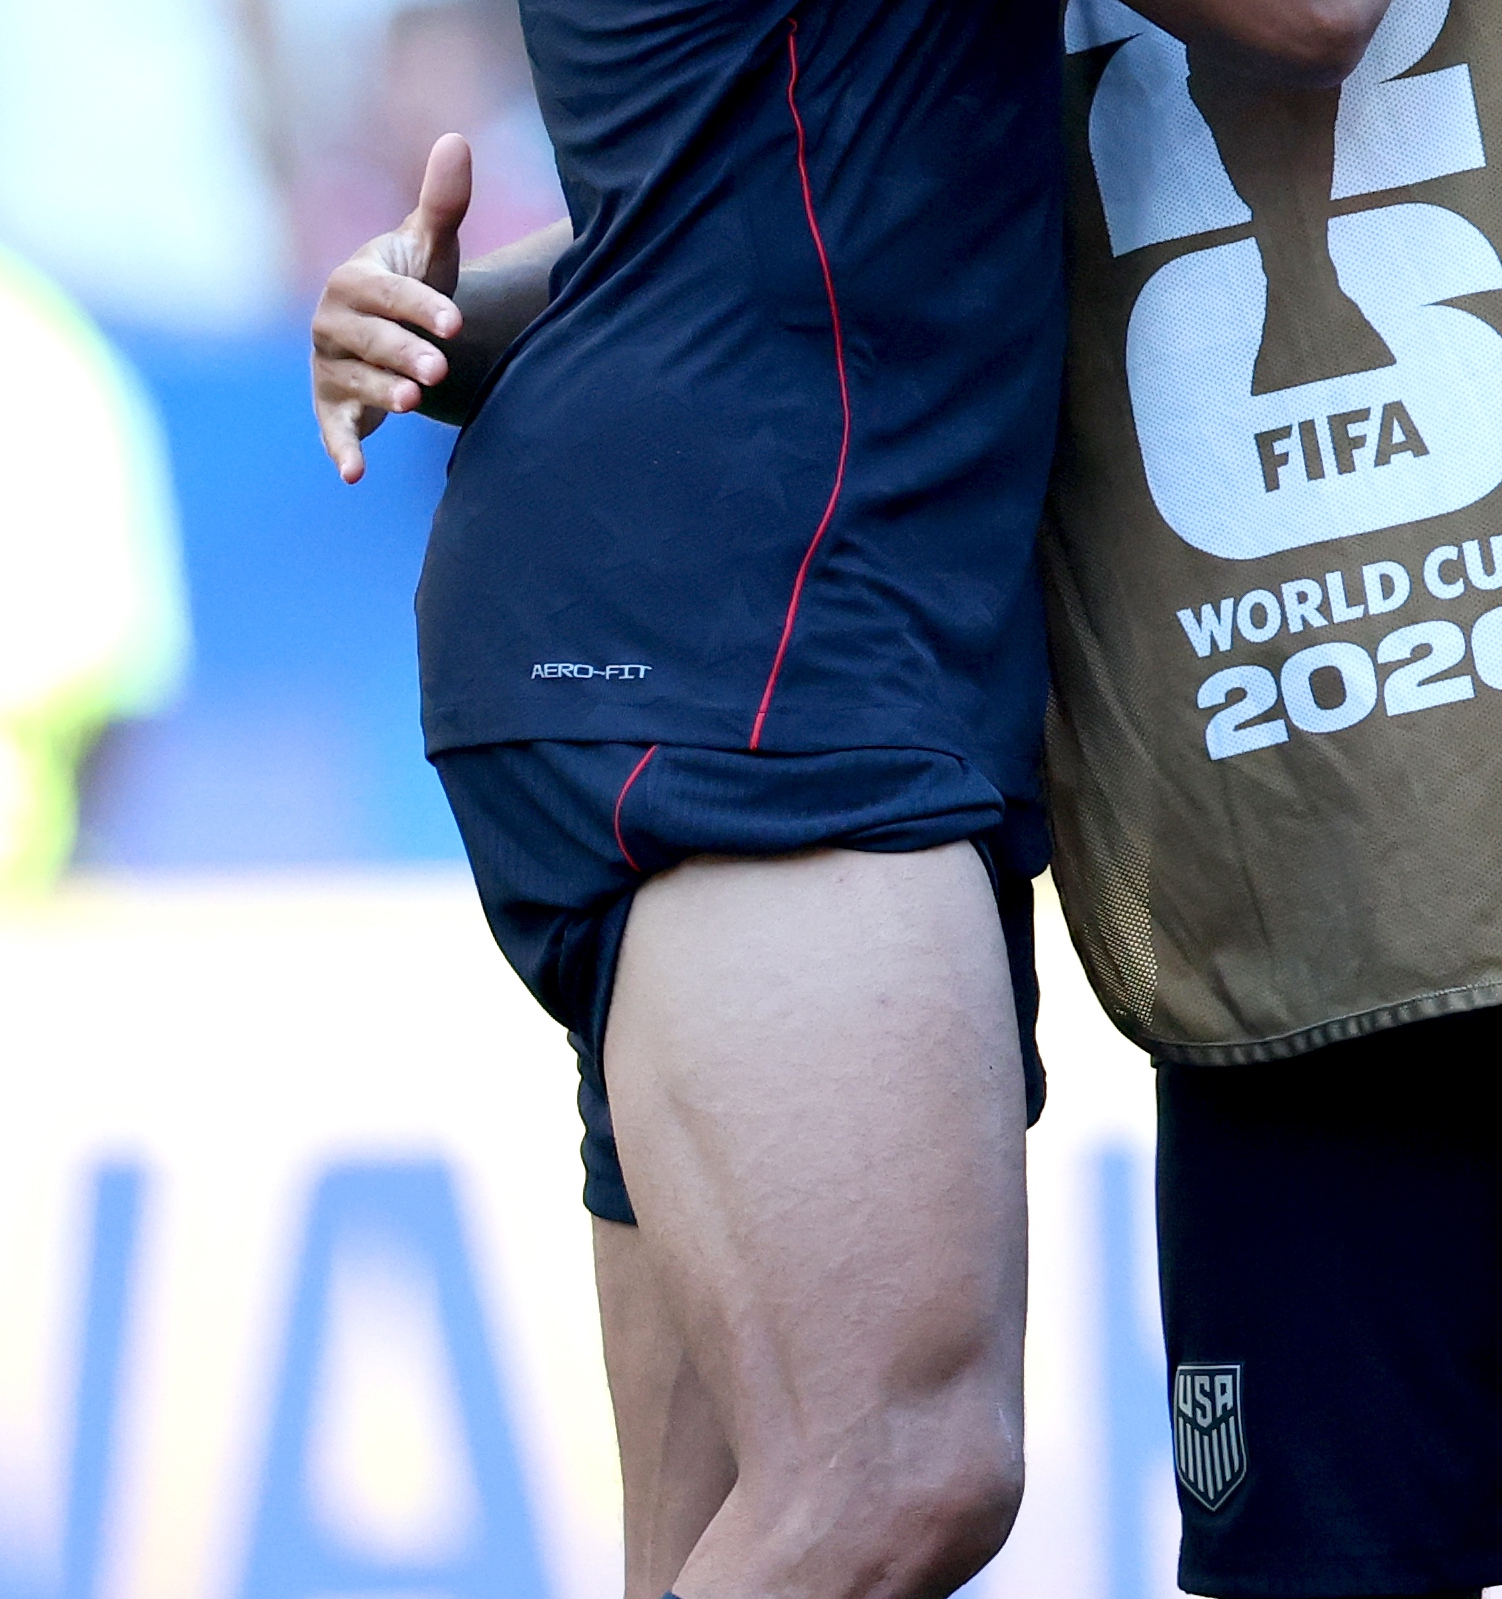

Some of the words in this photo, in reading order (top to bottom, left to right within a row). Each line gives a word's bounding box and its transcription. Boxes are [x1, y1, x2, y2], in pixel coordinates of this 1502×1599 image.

[1253, 399, 1431, 494] FIFA
[1176, 559, 1412, 660] WORLD
[530, 662, 653, 681] AERO-FIT
[1178, 1374, 1235, 1429] USA
